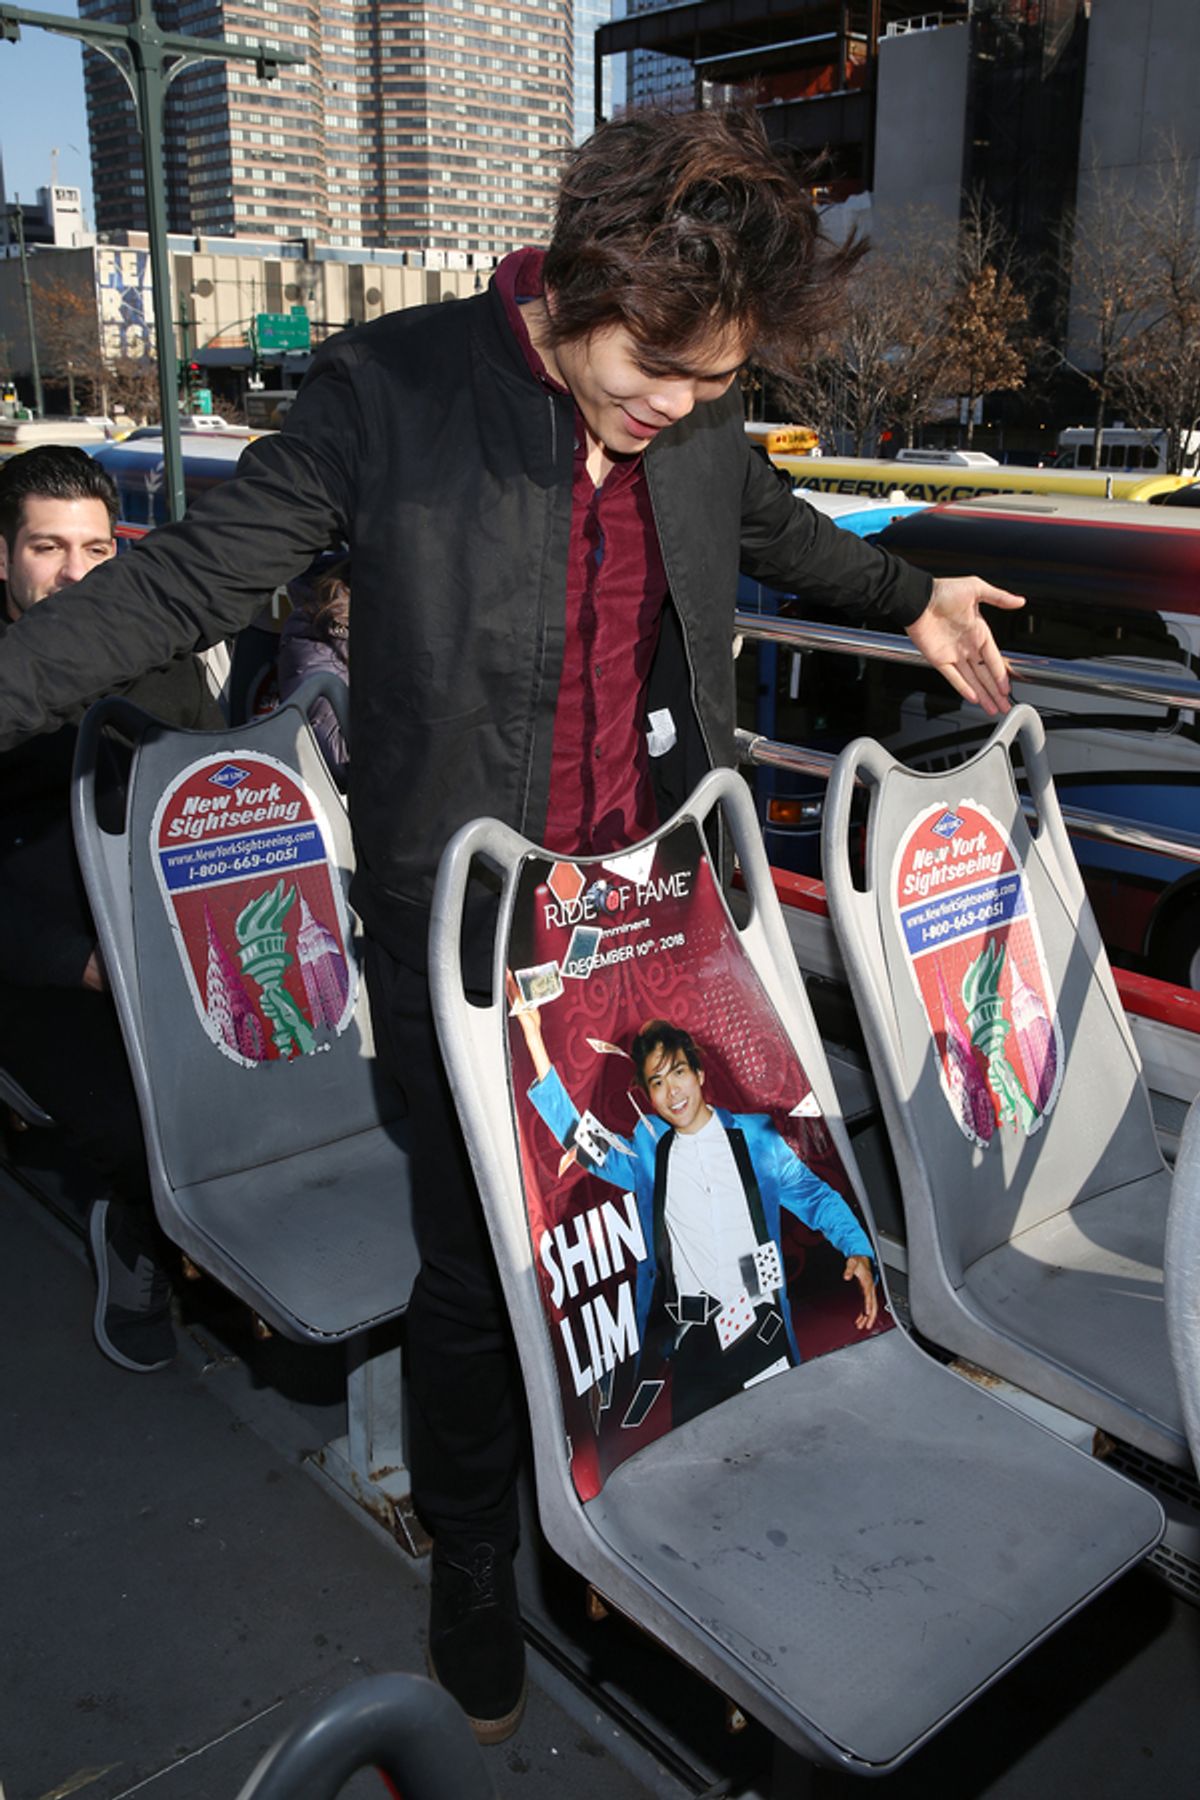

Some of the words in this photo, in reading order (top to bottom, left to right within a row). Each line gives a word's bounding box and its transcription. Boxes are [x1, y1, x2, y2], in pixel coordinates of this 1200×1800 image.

[791, 476, 1034, 503] WATERWAY.C
[182, 794, 232, 816] New
[234, 783, 282, 807] York
[167, 801, 301, 838] Sightseeing
[167, 830, 316, 867] www.NewYorkSightseeing.com
[189, 847, 298, 880] 1-800-669-0051
[912, 846, 949, 871] New
[952, 831, 988, 859] York
[903, 851, 1004, 896] Sightseeing
[544, 895, 598, 930] RIDE
[568, 945, 634, 976] DECEMBER
[659, 933, 686, 950] 2018
[539, 1191, 648, 1310] SHIN
[559, 1280, 640, 1398] LIM
